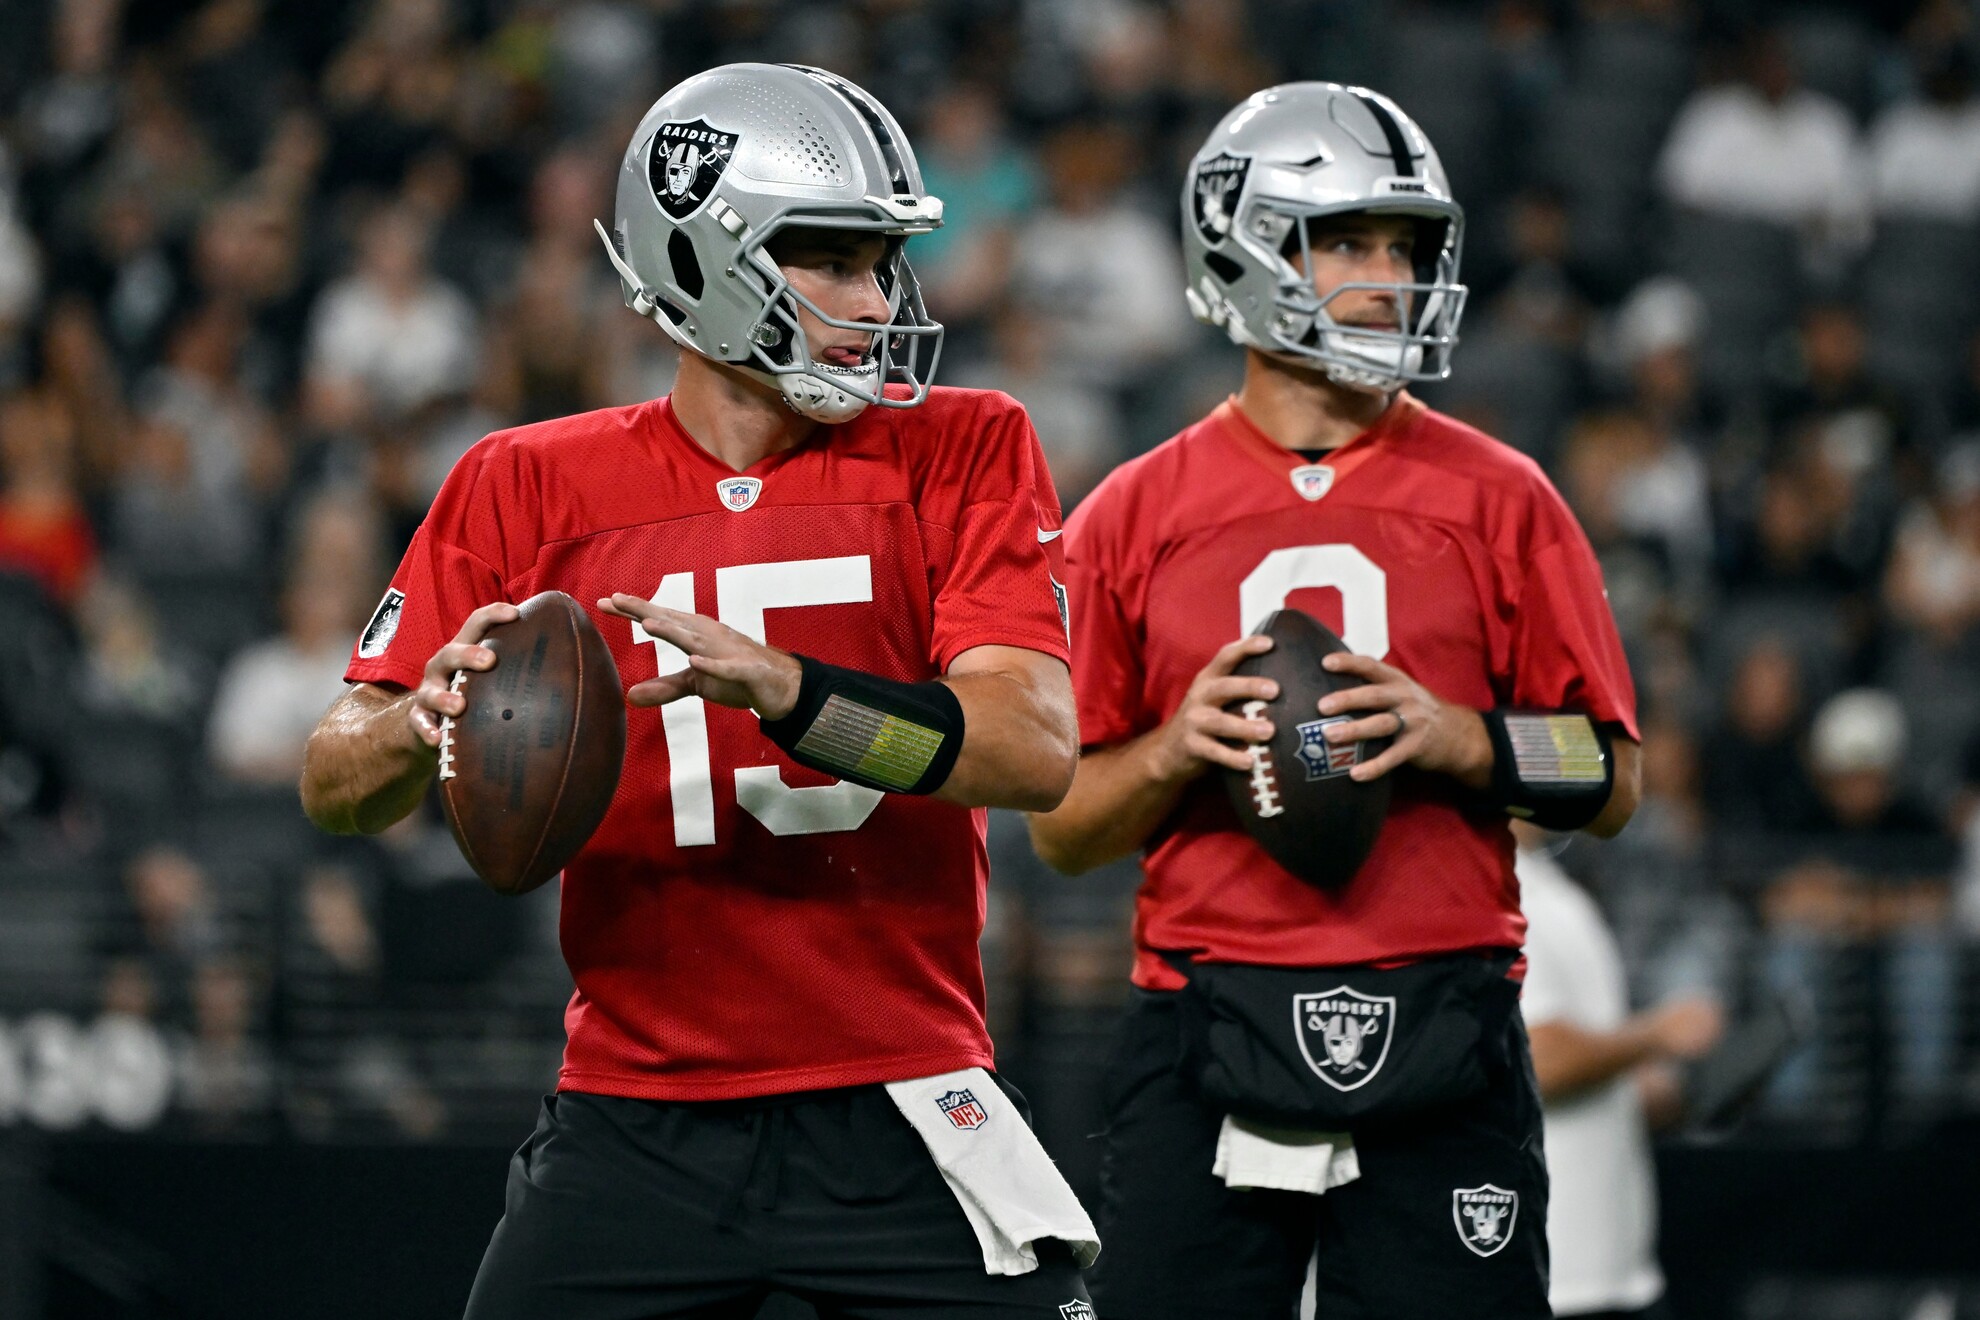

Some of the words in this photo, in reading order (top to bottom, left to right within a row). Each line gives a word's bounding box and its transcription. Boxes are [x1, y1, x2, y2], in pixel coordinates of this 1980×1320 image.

[662, 125, 729, 146] RAIDERS
[722, 481, 757, 489] EQUIPMENT
[731, 494, 748, 505] NFL
[631, 555, 886, 848] 15
[1305, 1000, 1384, 1017] RAIDERS
[948, 1103, 985, 1127] NFL
